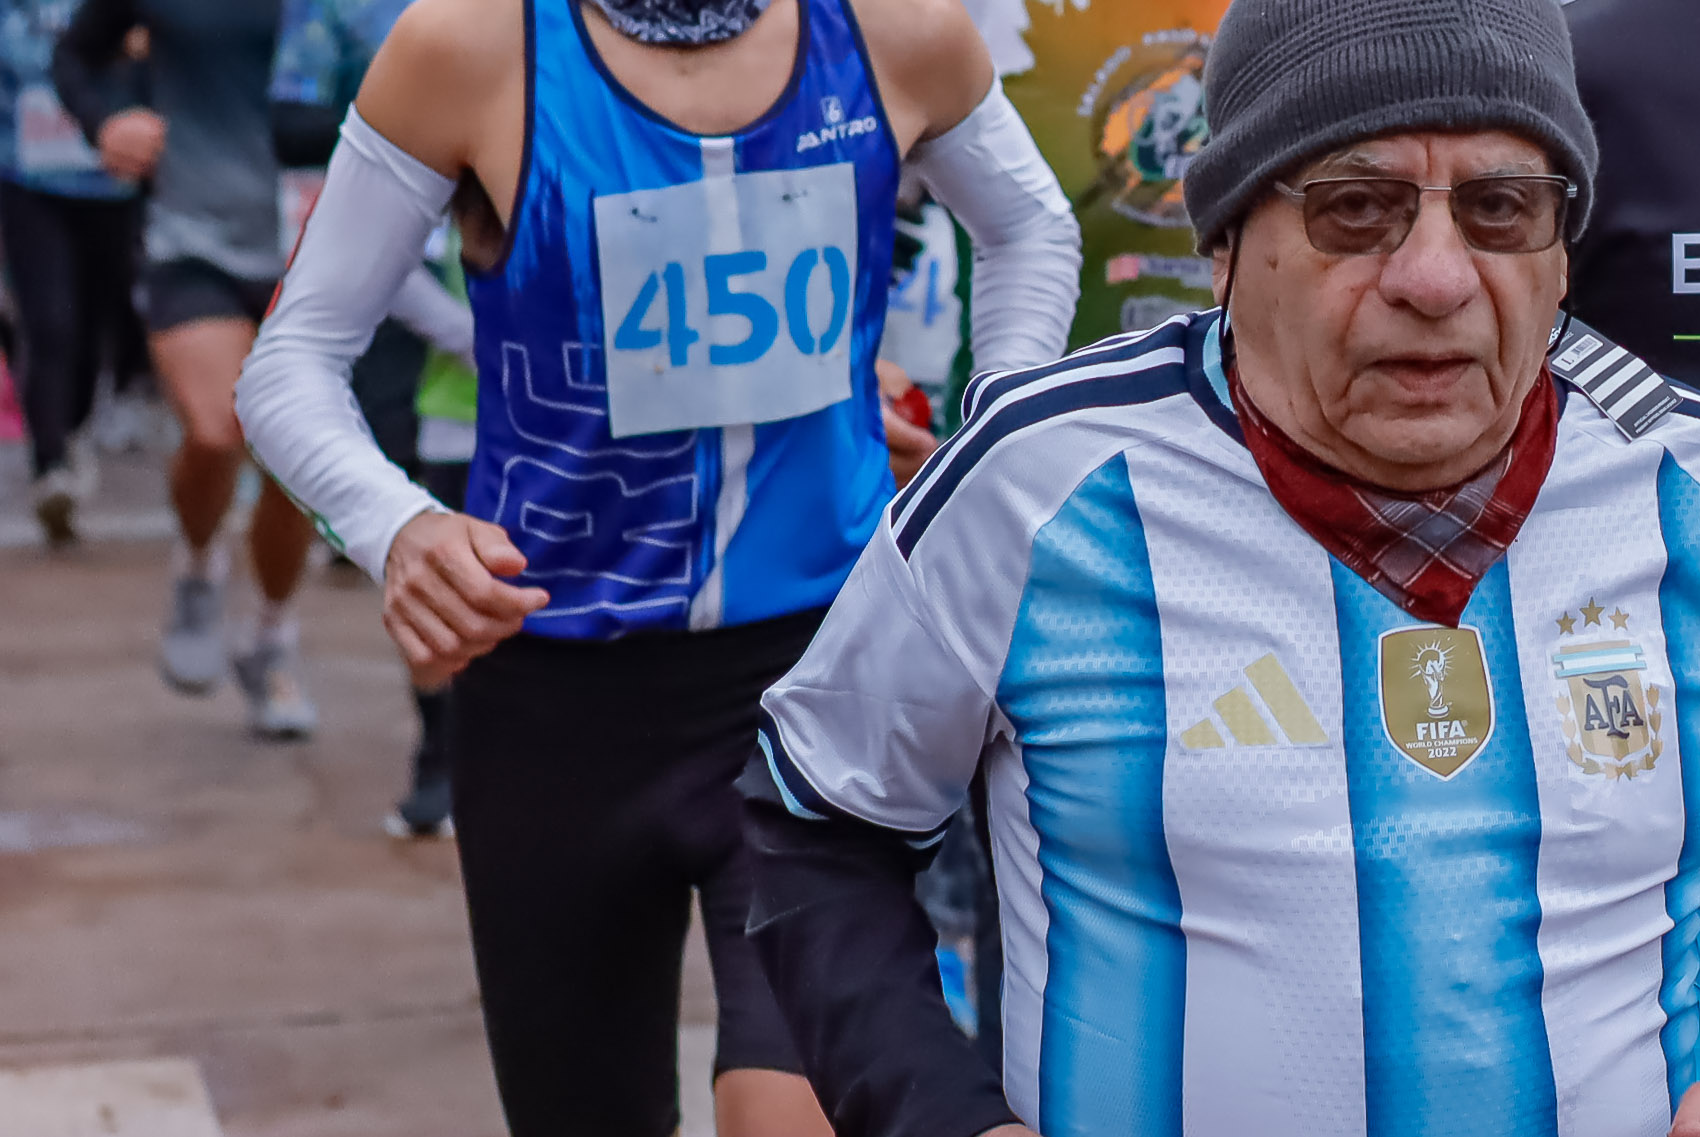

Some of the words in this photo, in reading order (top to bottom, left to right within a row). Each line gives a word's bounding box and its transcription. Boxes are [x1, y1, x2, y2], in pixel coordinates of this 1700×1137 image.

[613, 246, 850, 366] 450
[1583, 674, 1644, 740] AFA
[1416, 720, 1466, 740] FIFA
[1406, 741, 1433, 749] WORLD
[1434, 737, 1478, 747] CHAMPIONS
[1427, 747, 1457, 759] 2022
